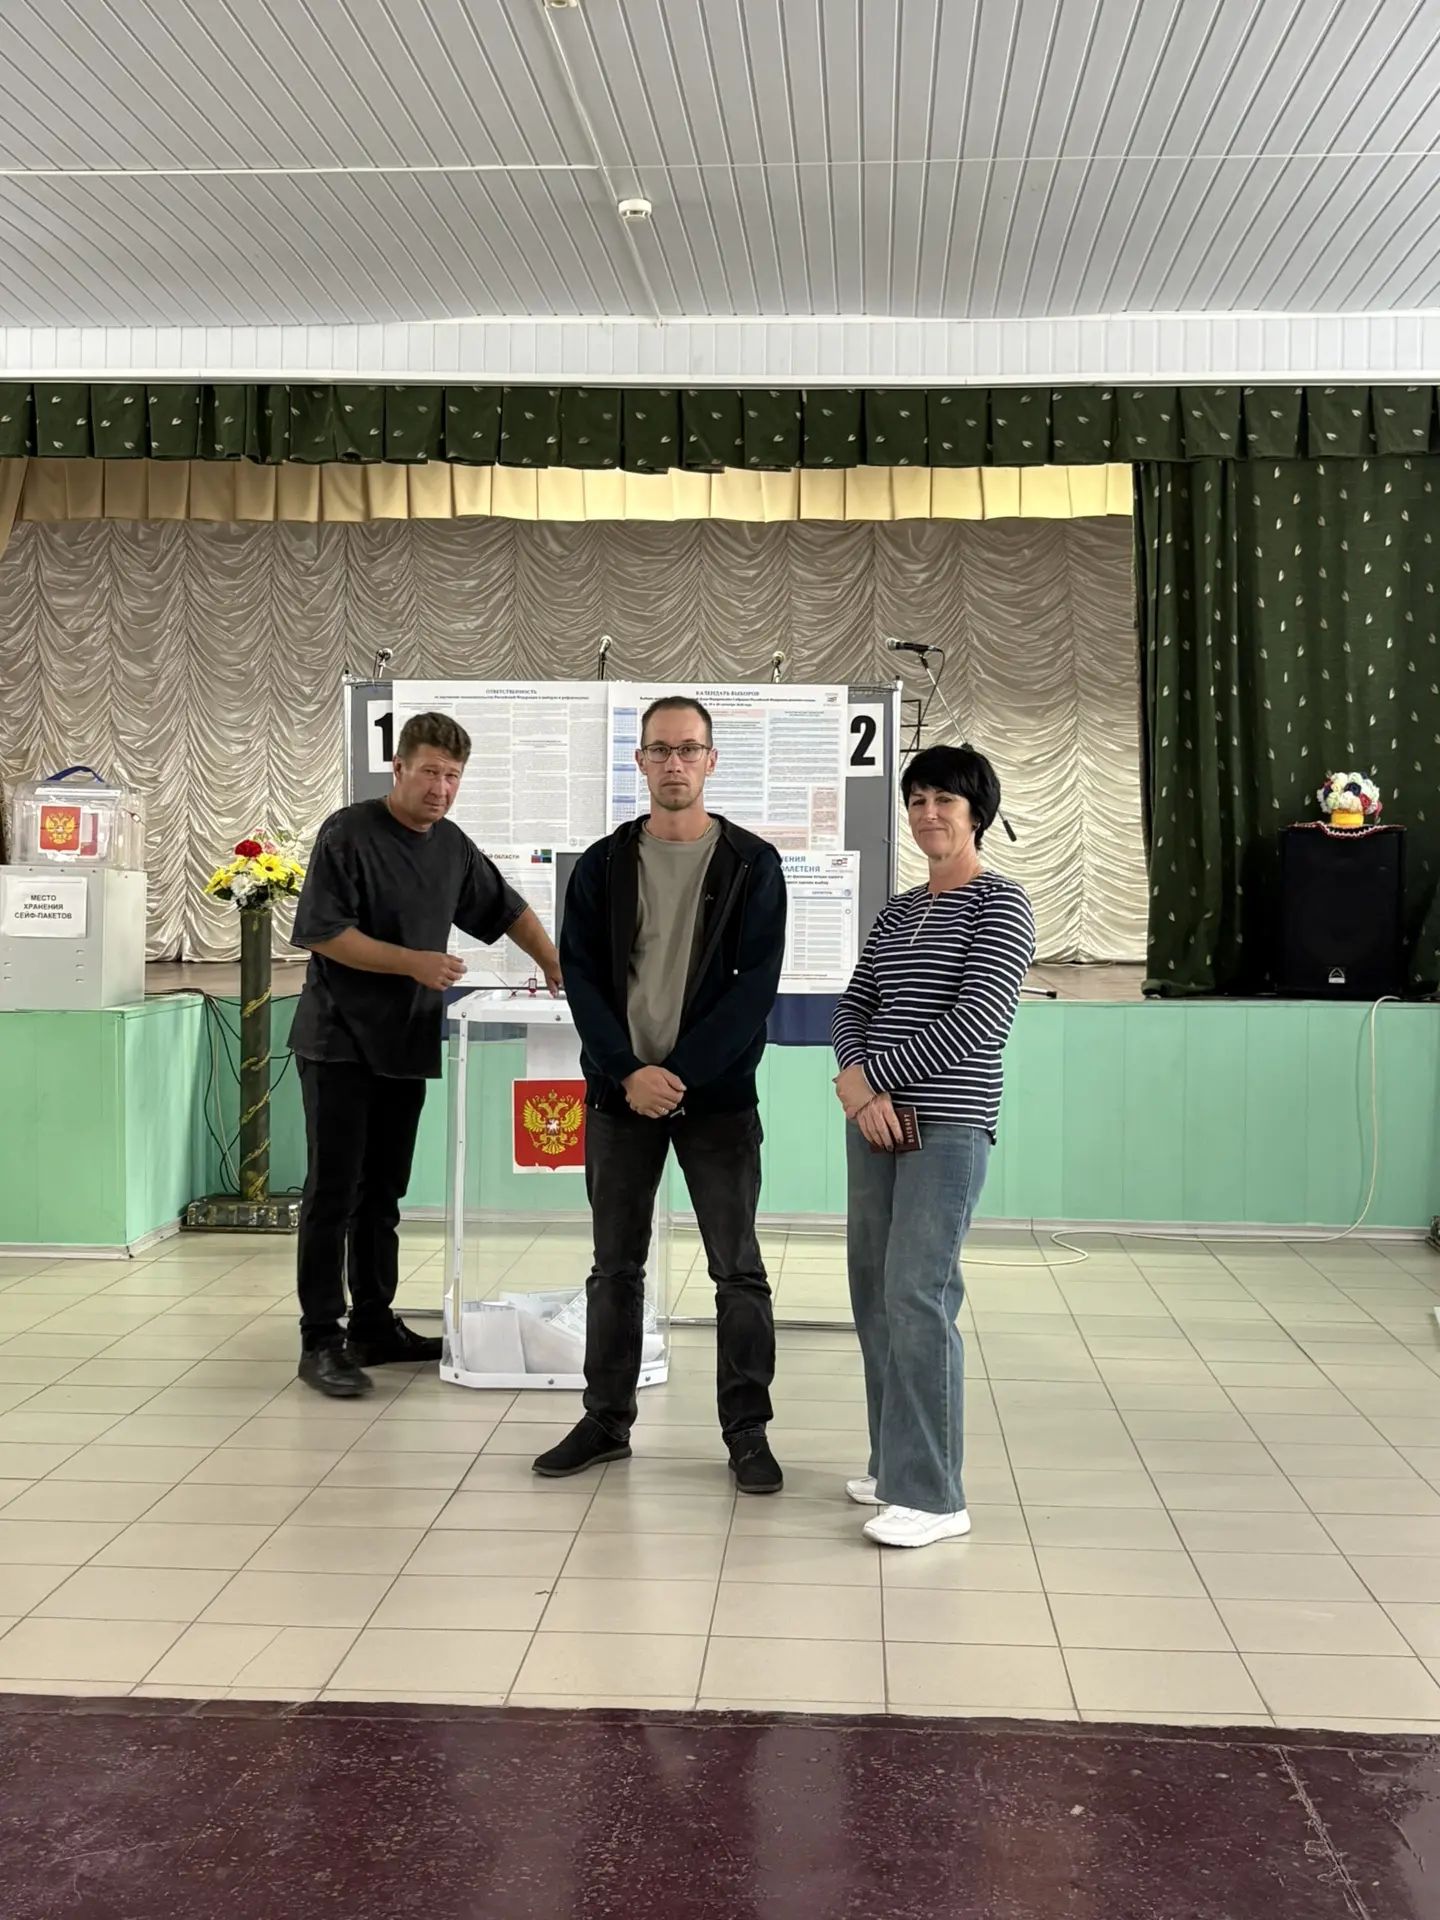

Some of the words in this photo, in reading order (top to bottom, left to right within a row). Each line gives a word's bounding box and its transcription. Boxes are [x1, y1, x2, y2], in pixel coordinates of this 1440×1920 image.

[374, 712, 393, 762] 1
[850, 715, 877, 766] 2
[14, 911, 73, 919] СЕЙФ-ПАКЕТОВ
